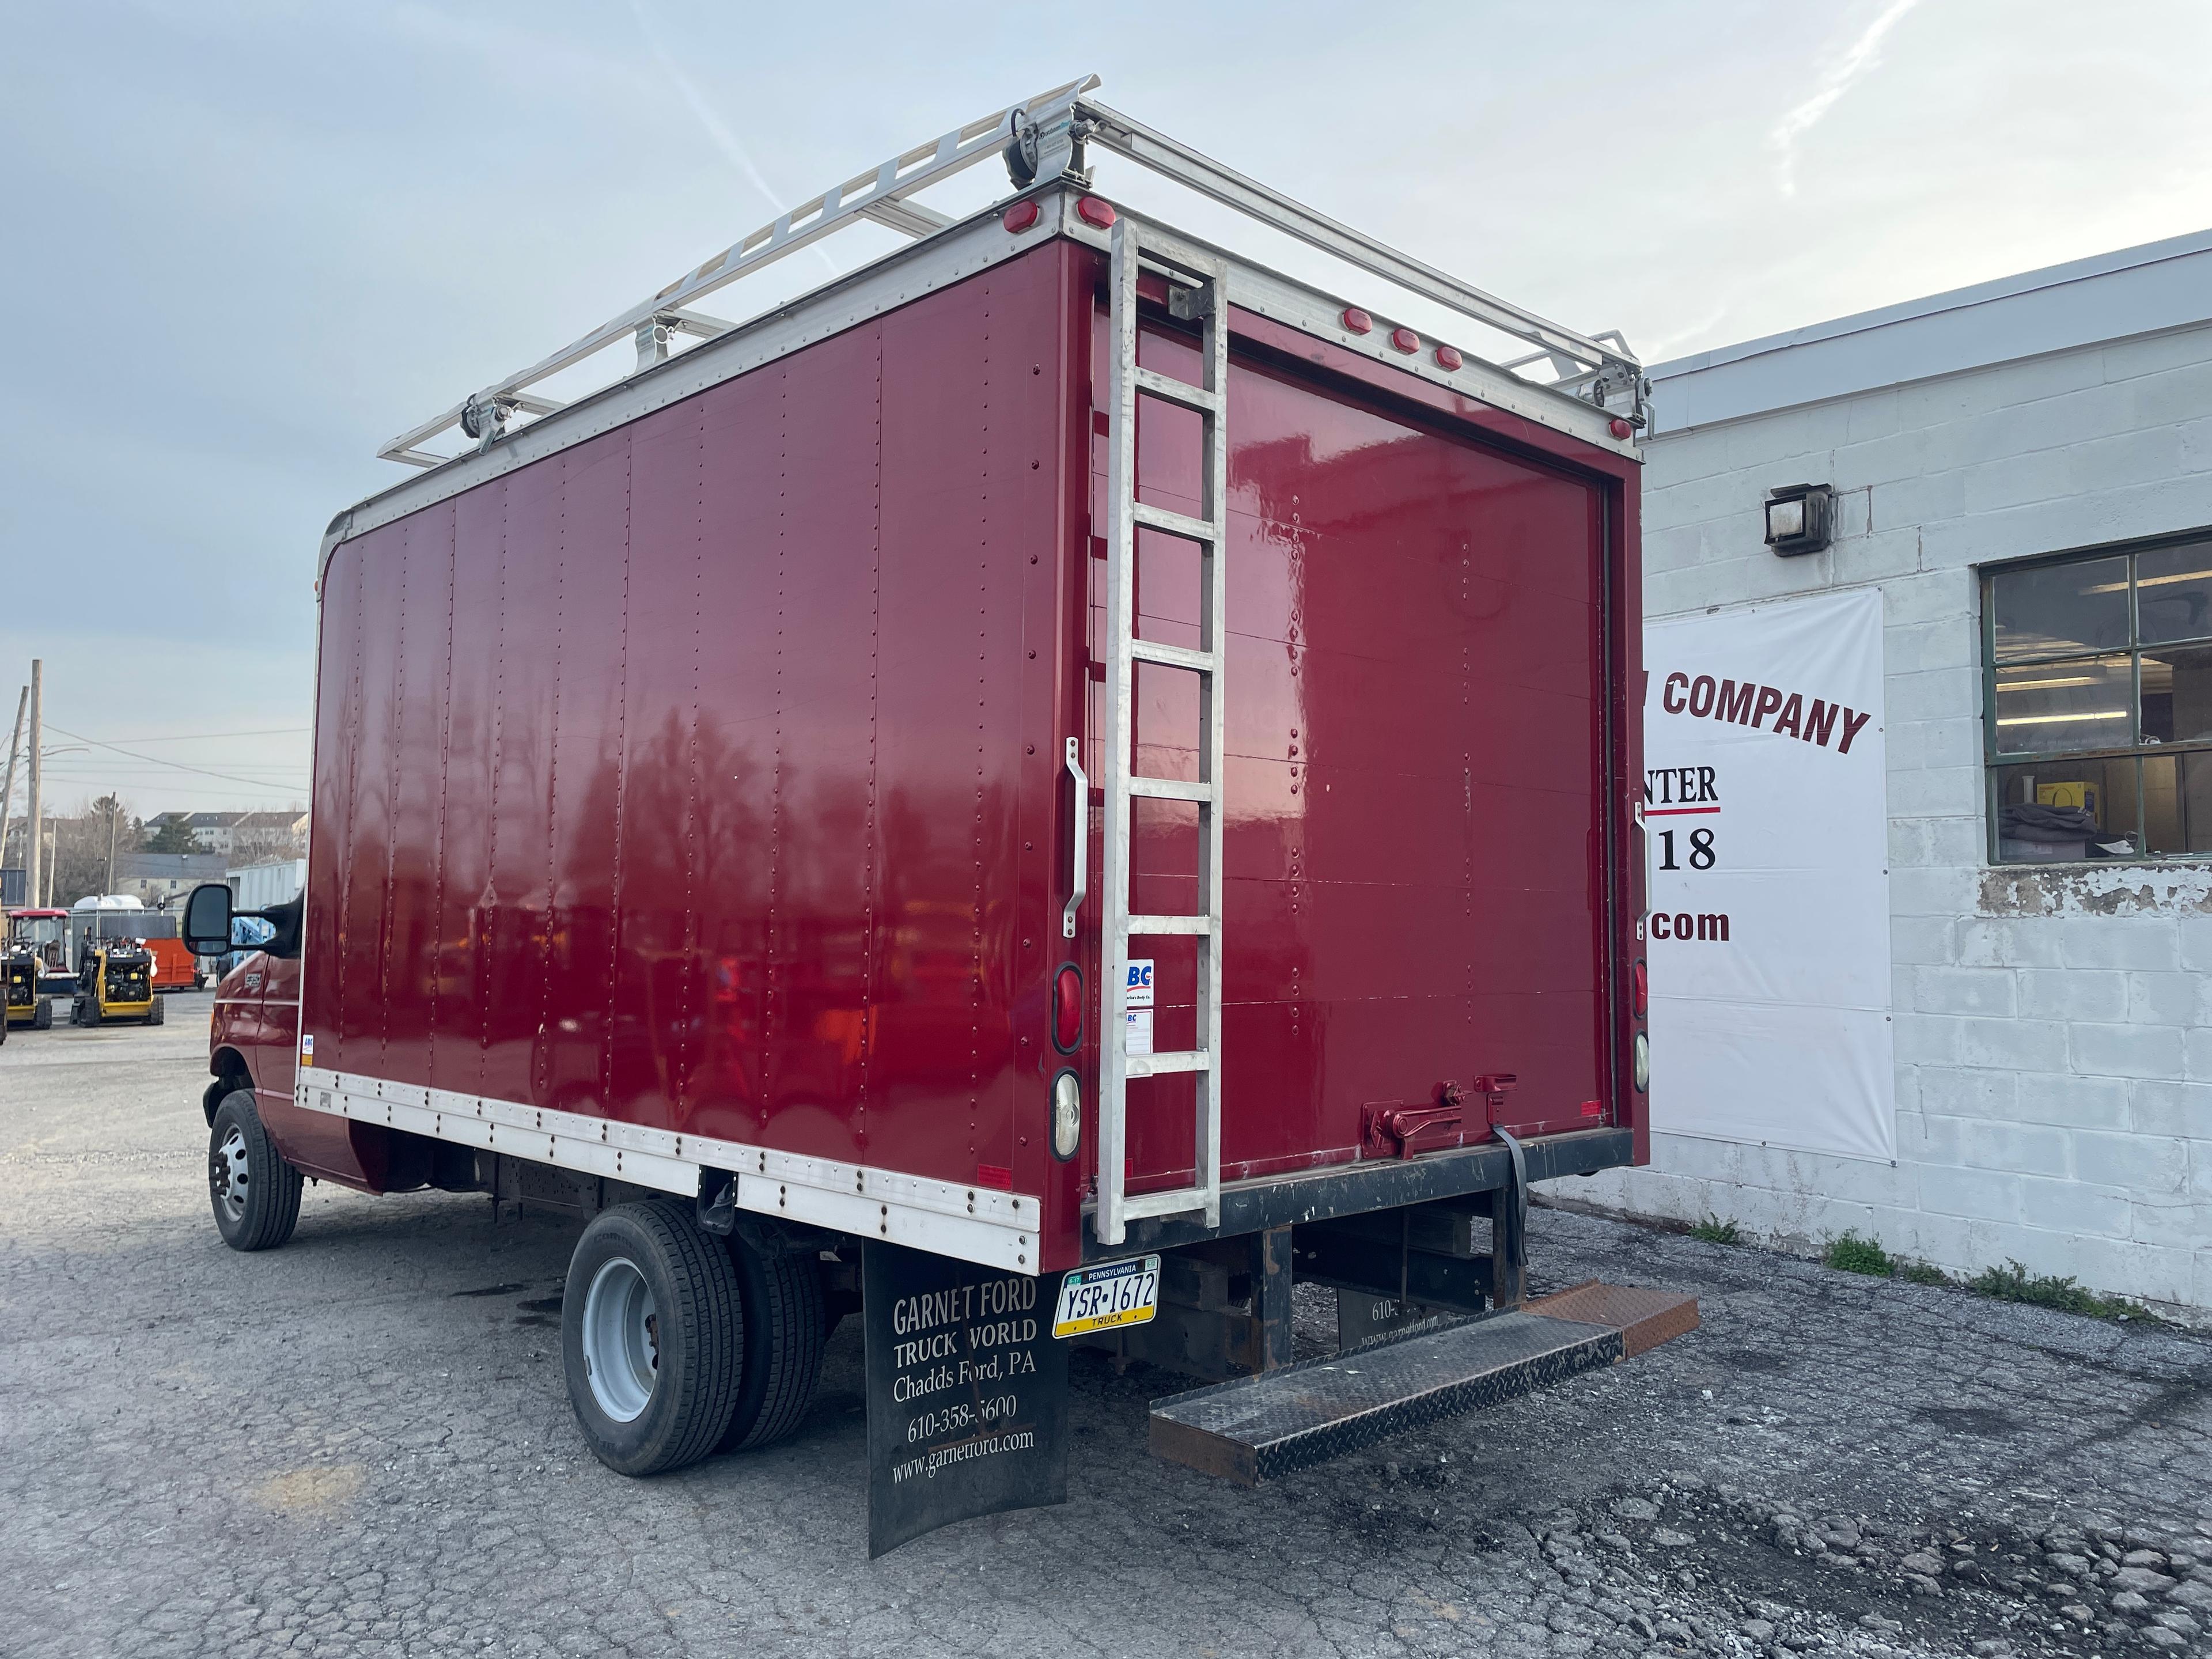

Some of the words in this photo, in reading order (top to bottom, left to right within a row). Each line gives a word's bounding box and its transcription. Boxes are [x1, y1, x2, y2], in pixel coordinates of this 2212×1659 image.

[1664, 672, 1872, 755] COMPANY
[1658, 828, 1716, 870] 18
[1127, 965, 1152, 986] BC
[1088, 1264, 1137, 1281] PENNSYLVANIA
[893, 1285, 975, 1335] GARNET
[980, 1276, 1036, 1317] FORD
[1092, 1313, 1123, 1327] TRUCK
[893, 1331, 957, 1369] TRUCK
[893, 1365, 954, 1403] Chadds
[1008, 1350, 1037, 1375] PA
